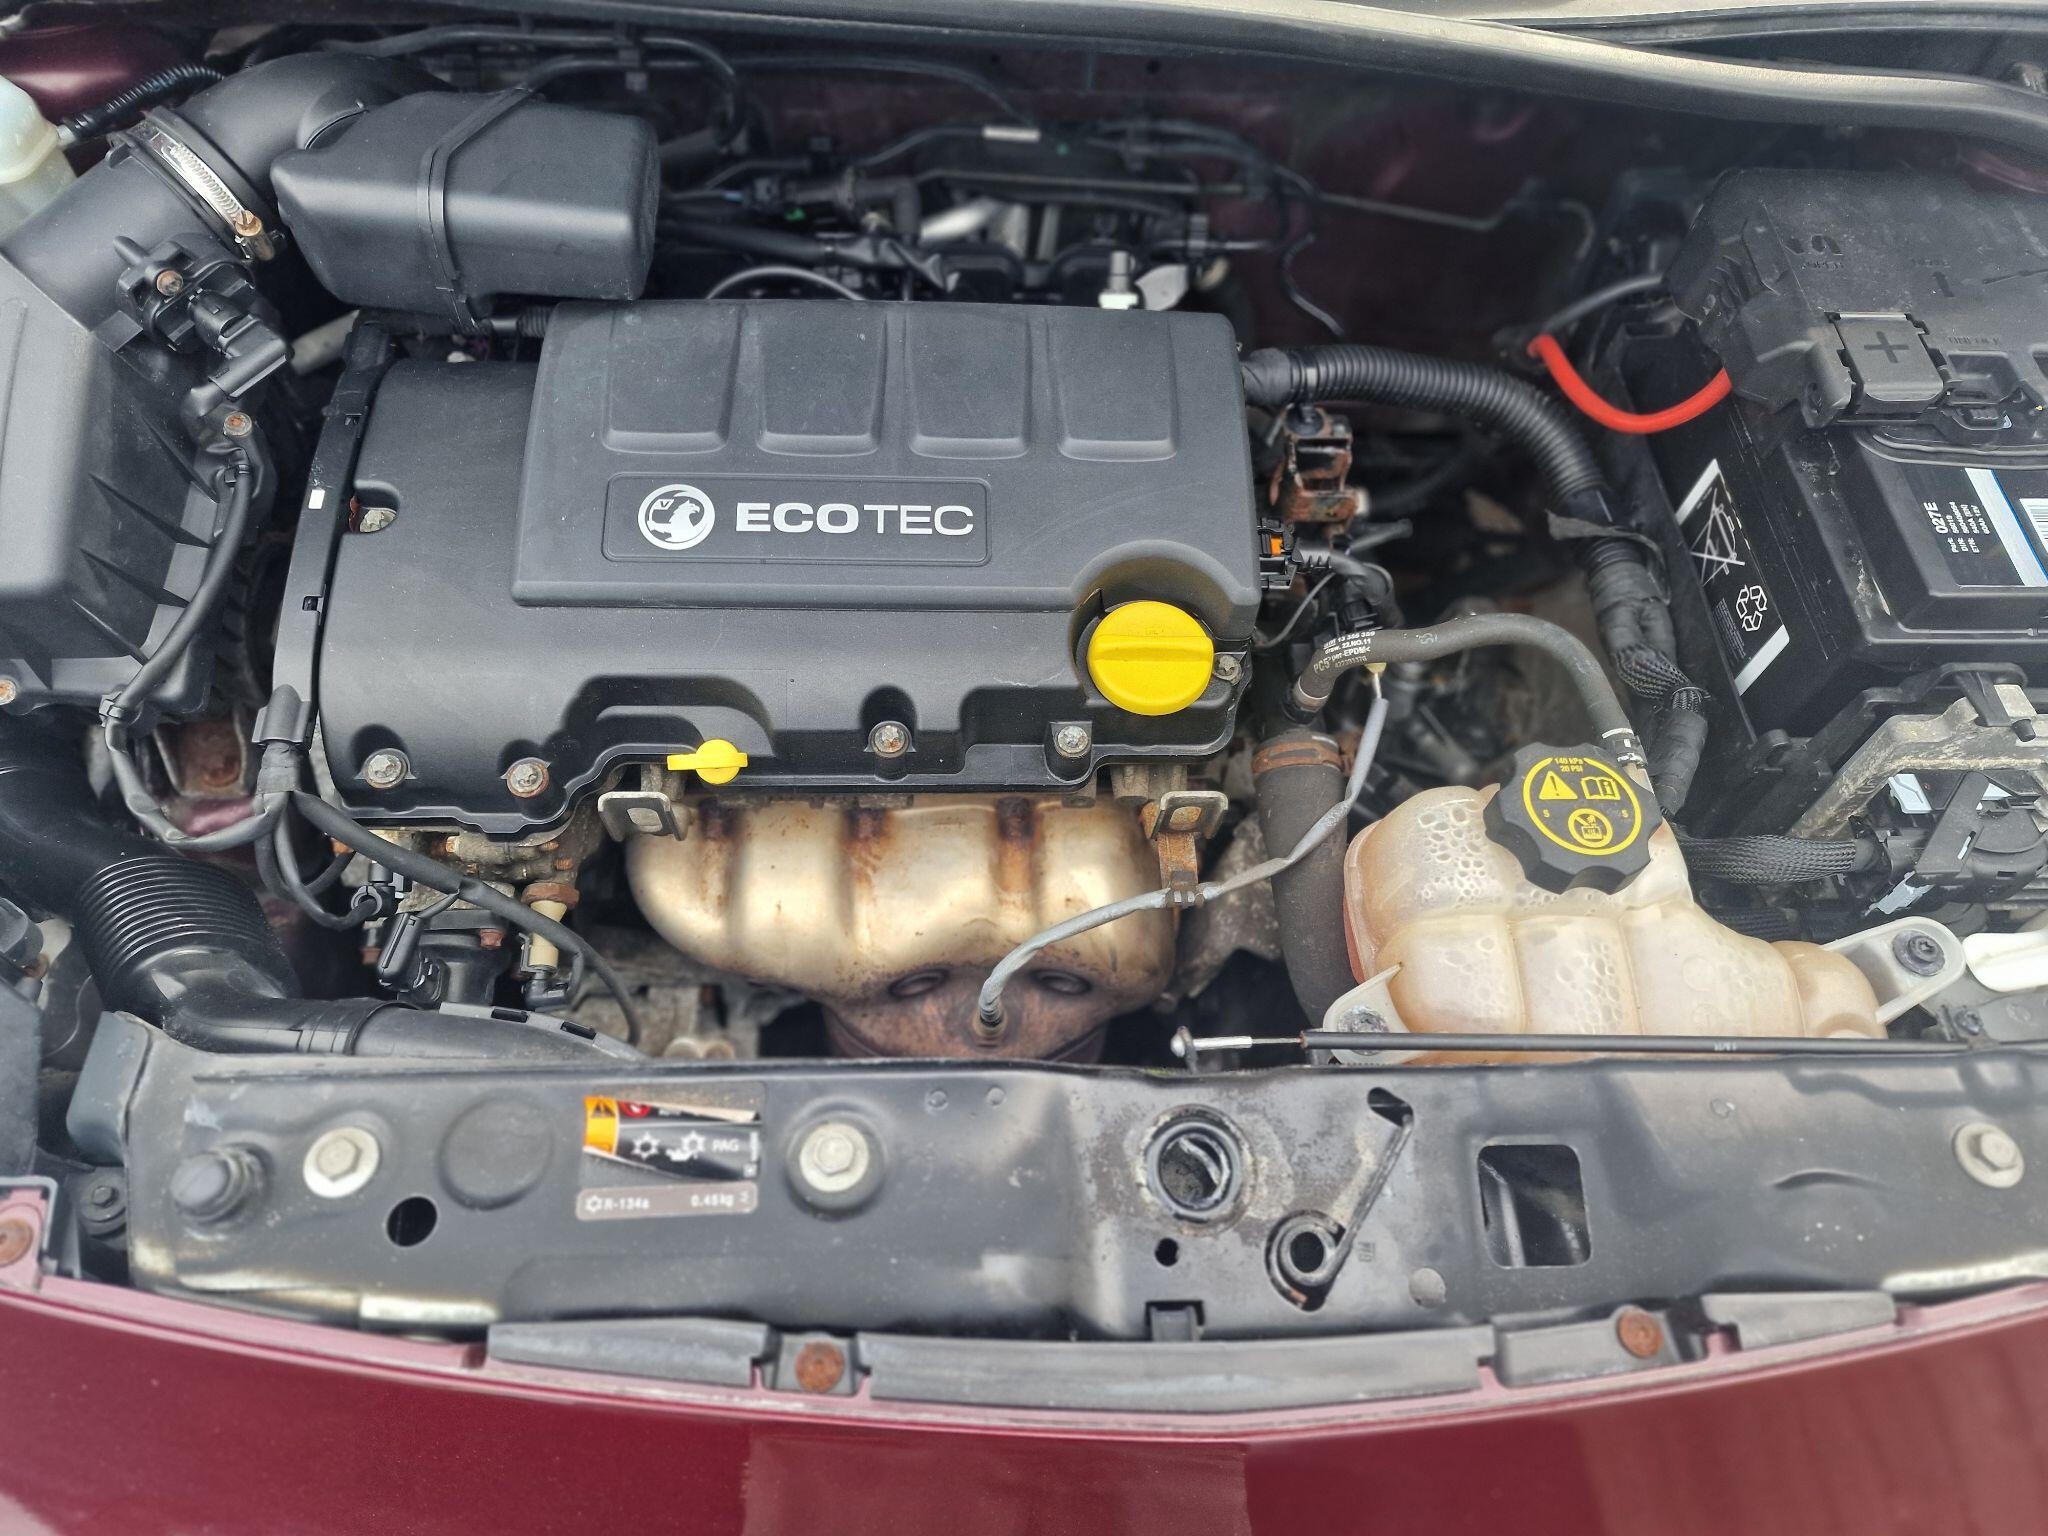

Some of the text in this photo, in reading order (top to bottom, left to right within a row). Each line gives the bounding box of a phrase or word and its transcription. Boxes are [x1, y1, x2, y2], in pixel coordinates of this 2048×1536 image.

[735, 502, 975, 536] ECOTEC
[1923, 502, 1948, 534] 027E
[712, 1138, 740, 1152] PAG
